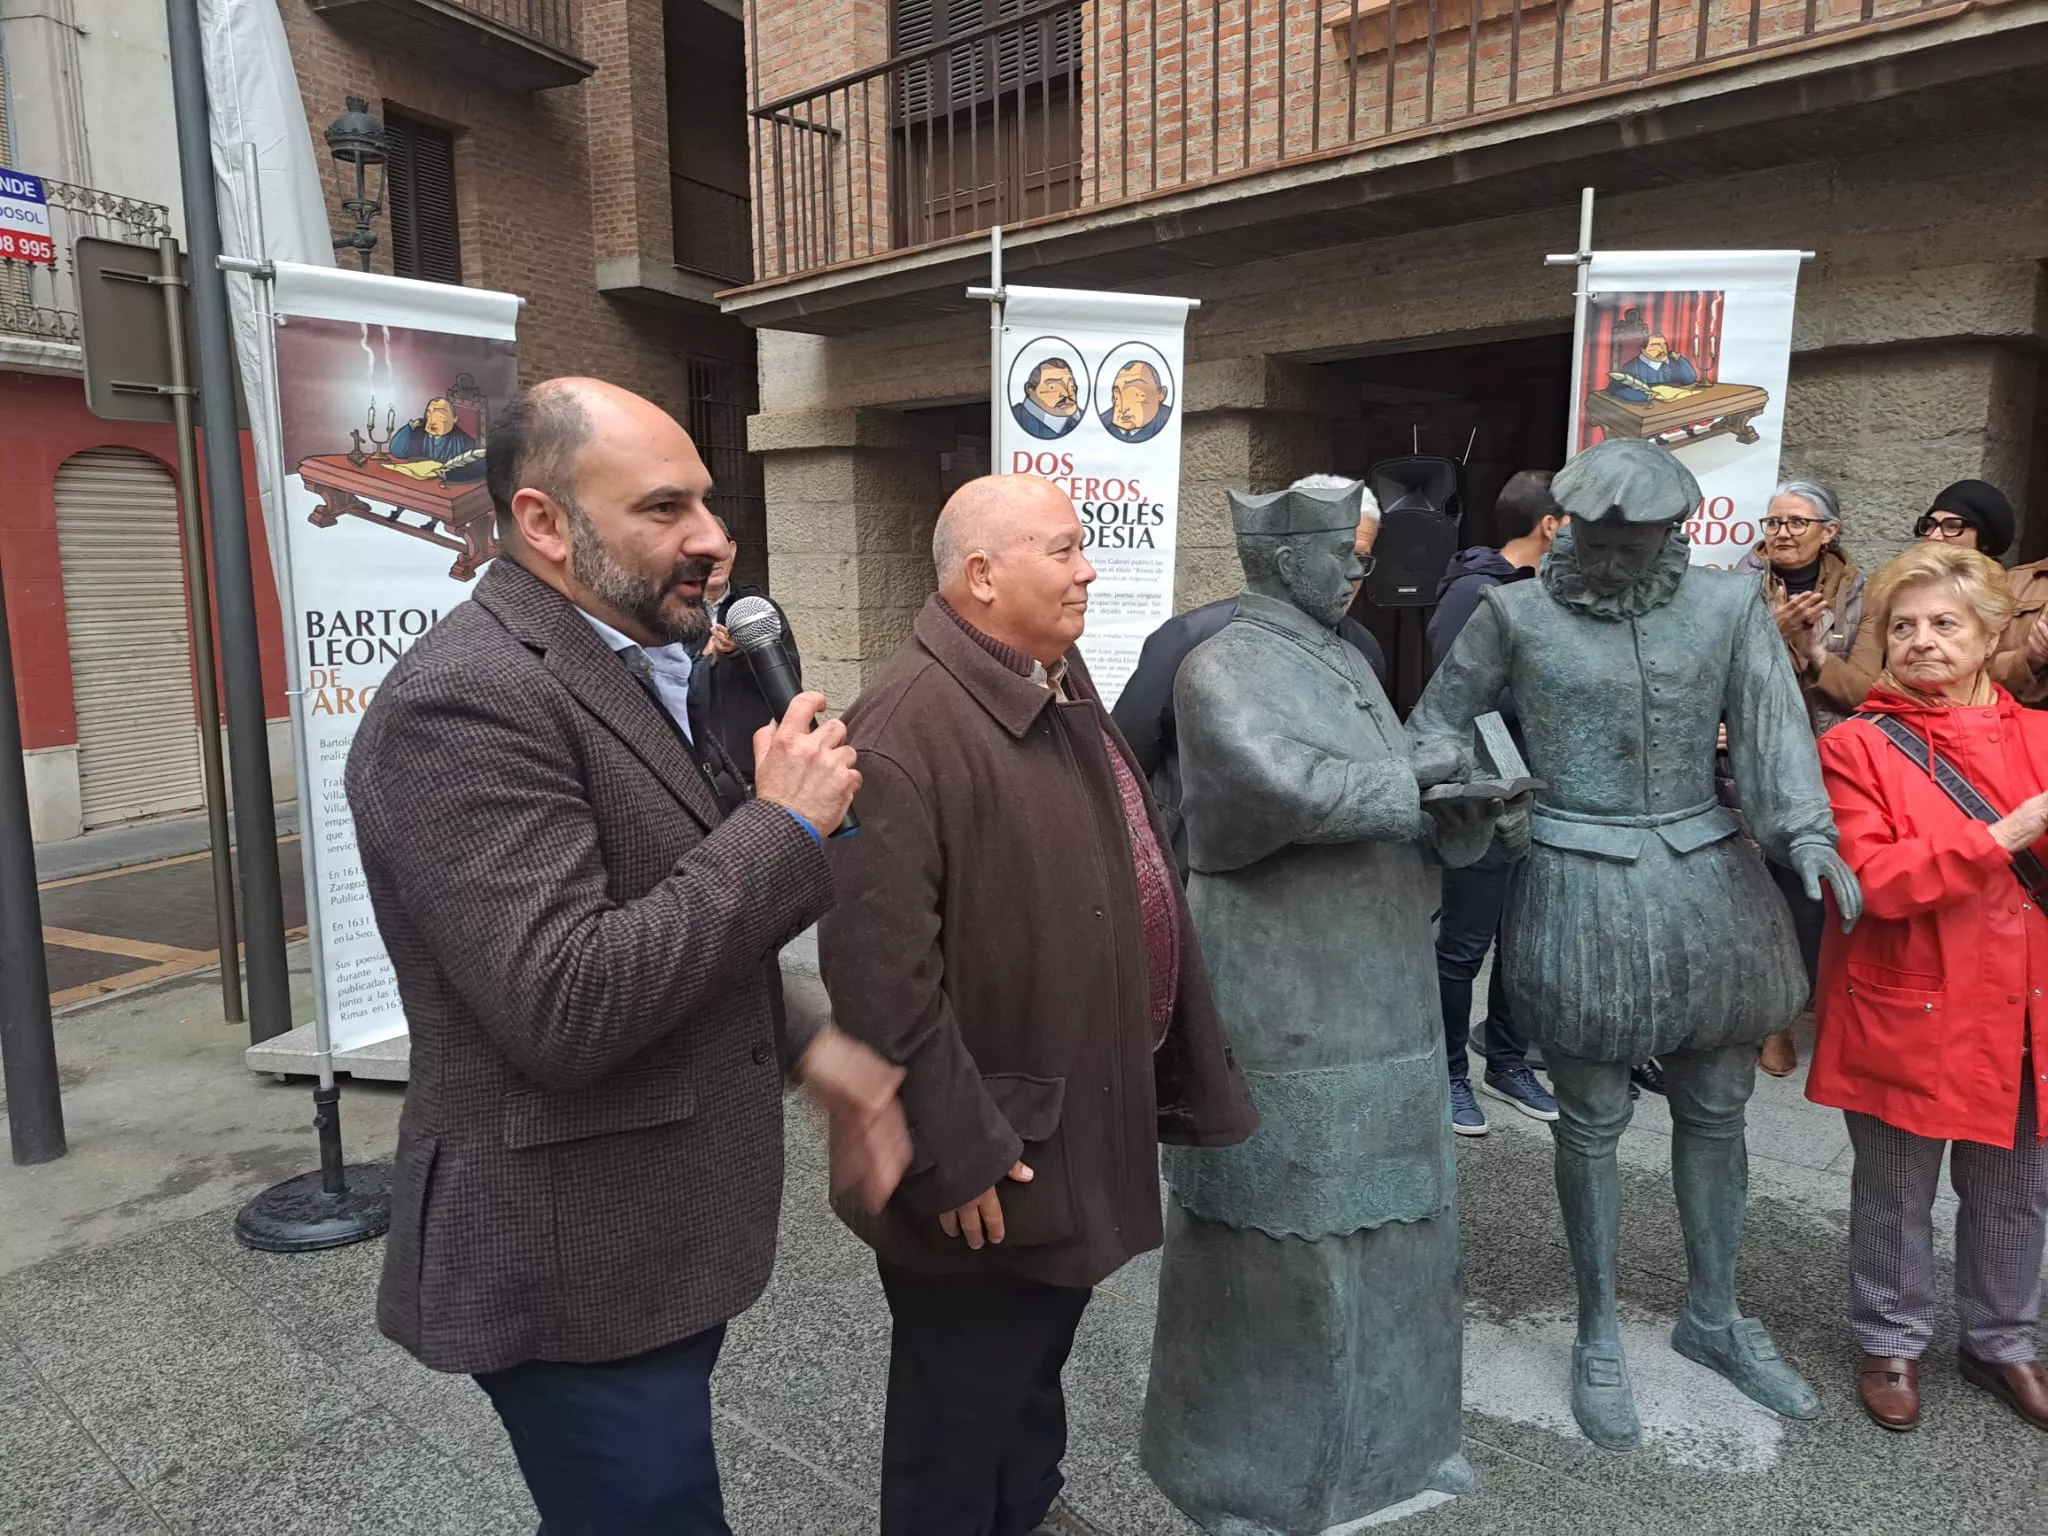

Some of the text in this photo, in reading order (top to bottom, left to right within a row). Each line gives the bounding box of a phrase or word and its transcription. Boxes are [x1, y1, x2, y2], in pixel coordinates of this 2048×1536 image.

[0, 235, 51, 259] 8 995
[1013, 451, 1074, 476] DOS
[1052, 476, 1147, 504] EROS,
[1082, 526, 1155, 549] ESIA
[1685, 521, 1755, 546] RDO
[306, 608, 438, 638] BARTO
[308, 637, 402, 667] LEON
[310, 668, 342, 689] DE
[312, 685, 379, 716] AR
[322, 776, 344, 788] Tra
[324, 803, 349, 814] Villa
[325, 816, 353, 828] empe
[326, 832, 344, 842] que
[329, 870, 340, 880] En
[331, 893, 365, 906] Publica
[332, 916, 369, 932] En 1631
[333, 936, 345, 945] en
[335, 960, 351, 971] Sus
[336, 969, 372, 984] durante
[338, 978, 386, 998] publicadas
[338, 998, 363, 1011] junto
[376, 990, 390, 1001] las
[340, 1008, 369, 1022] Rimas
[372, 1004, 384, 1014] en
